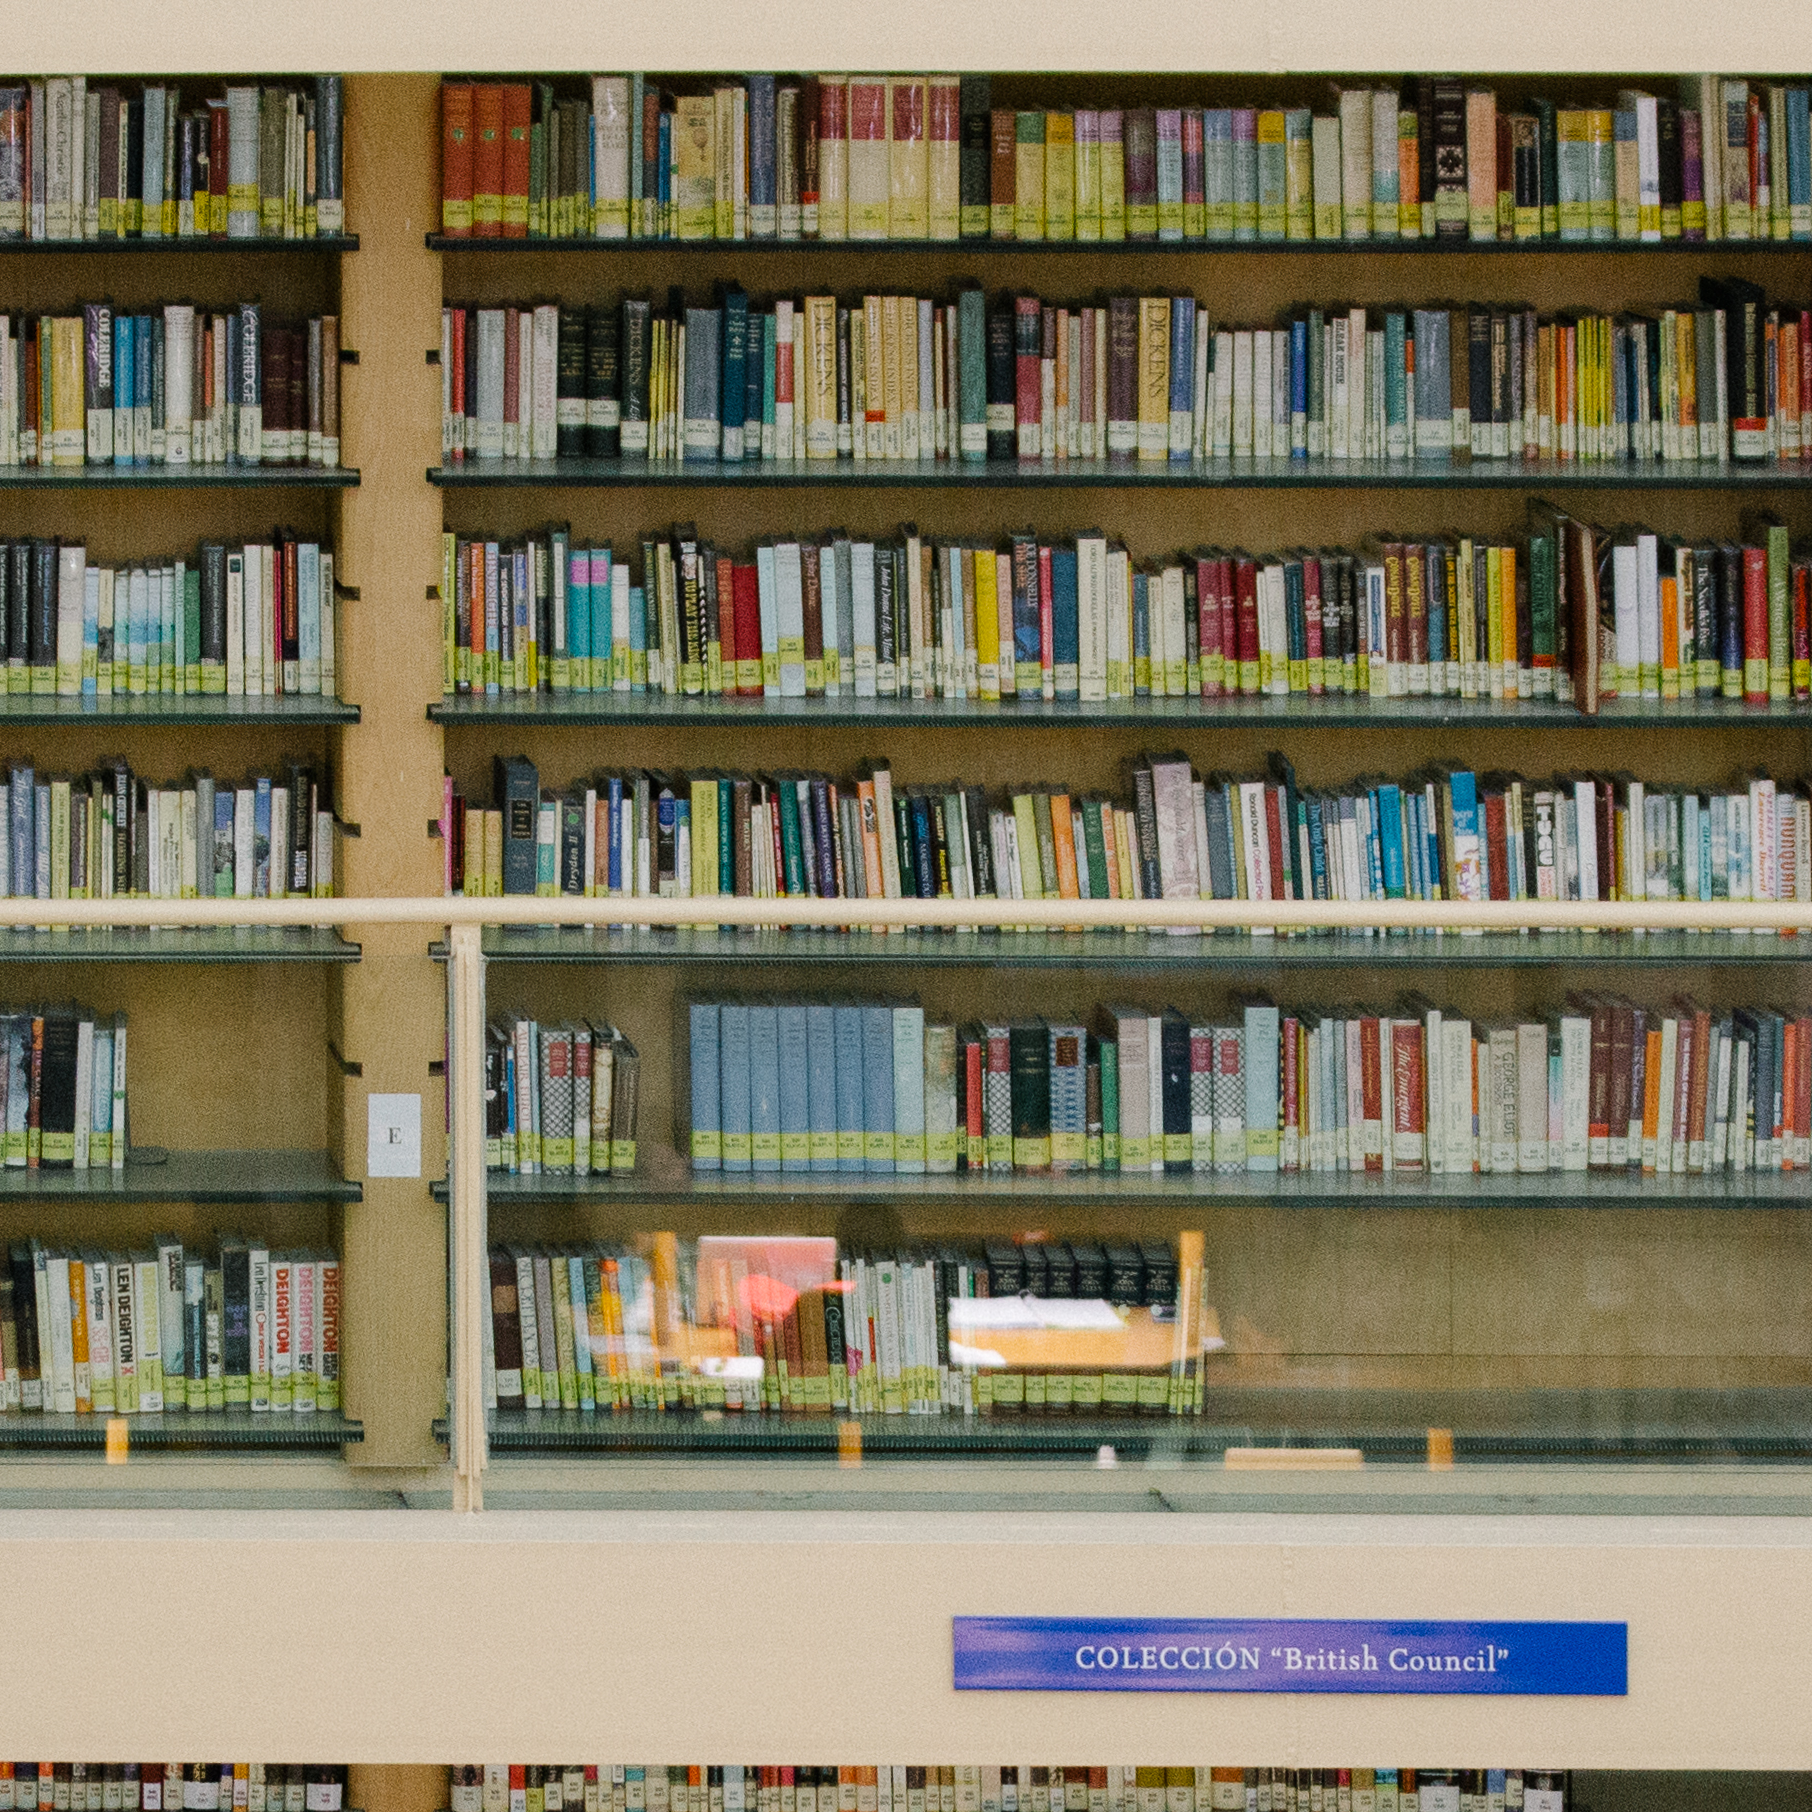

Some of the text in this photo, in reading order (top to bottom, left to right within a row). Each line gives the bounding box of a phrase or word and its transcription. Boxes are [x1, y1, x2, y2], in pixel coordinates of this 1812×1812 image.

[98, 309, 112, 387] COLERIDGE
[242, 309, 258, 402] COLERIDGE
[629, 318, 643, 385] DICKENS
[816, 303, 831, 396] DICKENS
[1150, 304, 1167, 398] DICKENS
[1026, 558, 1037, 608] DONNELLY
[1386, 557, 1400, 617] CONAN DOYLE
[1406, 557, 1421, 617] CONAN DOYLE
[1698, 566, 1707, 584] The
[687, 595, 697, 616] PLAY
[688, 619, 698, 637] THE
[1311, 804, 1321, 820] The
[567, 847, 580, 889] Dryden
[1314, 848, 1324, 871] Child
[1778, 818, 1795, 899] NUNQUAM
[388, 1126, 402, 1144] E
[116, 1269, 135, 1376] LEN DEIGHTON X
[142, 1267, 158, 1352] DEIGHTON
[207, 1314, 219, 1335] SPY
[276, 1269, 289, 1353] DEIGHTON
[297, 1268, 314, 1352] DEIGHTON
[1075, 1641, 1261, 1671] COLECCIÓN
